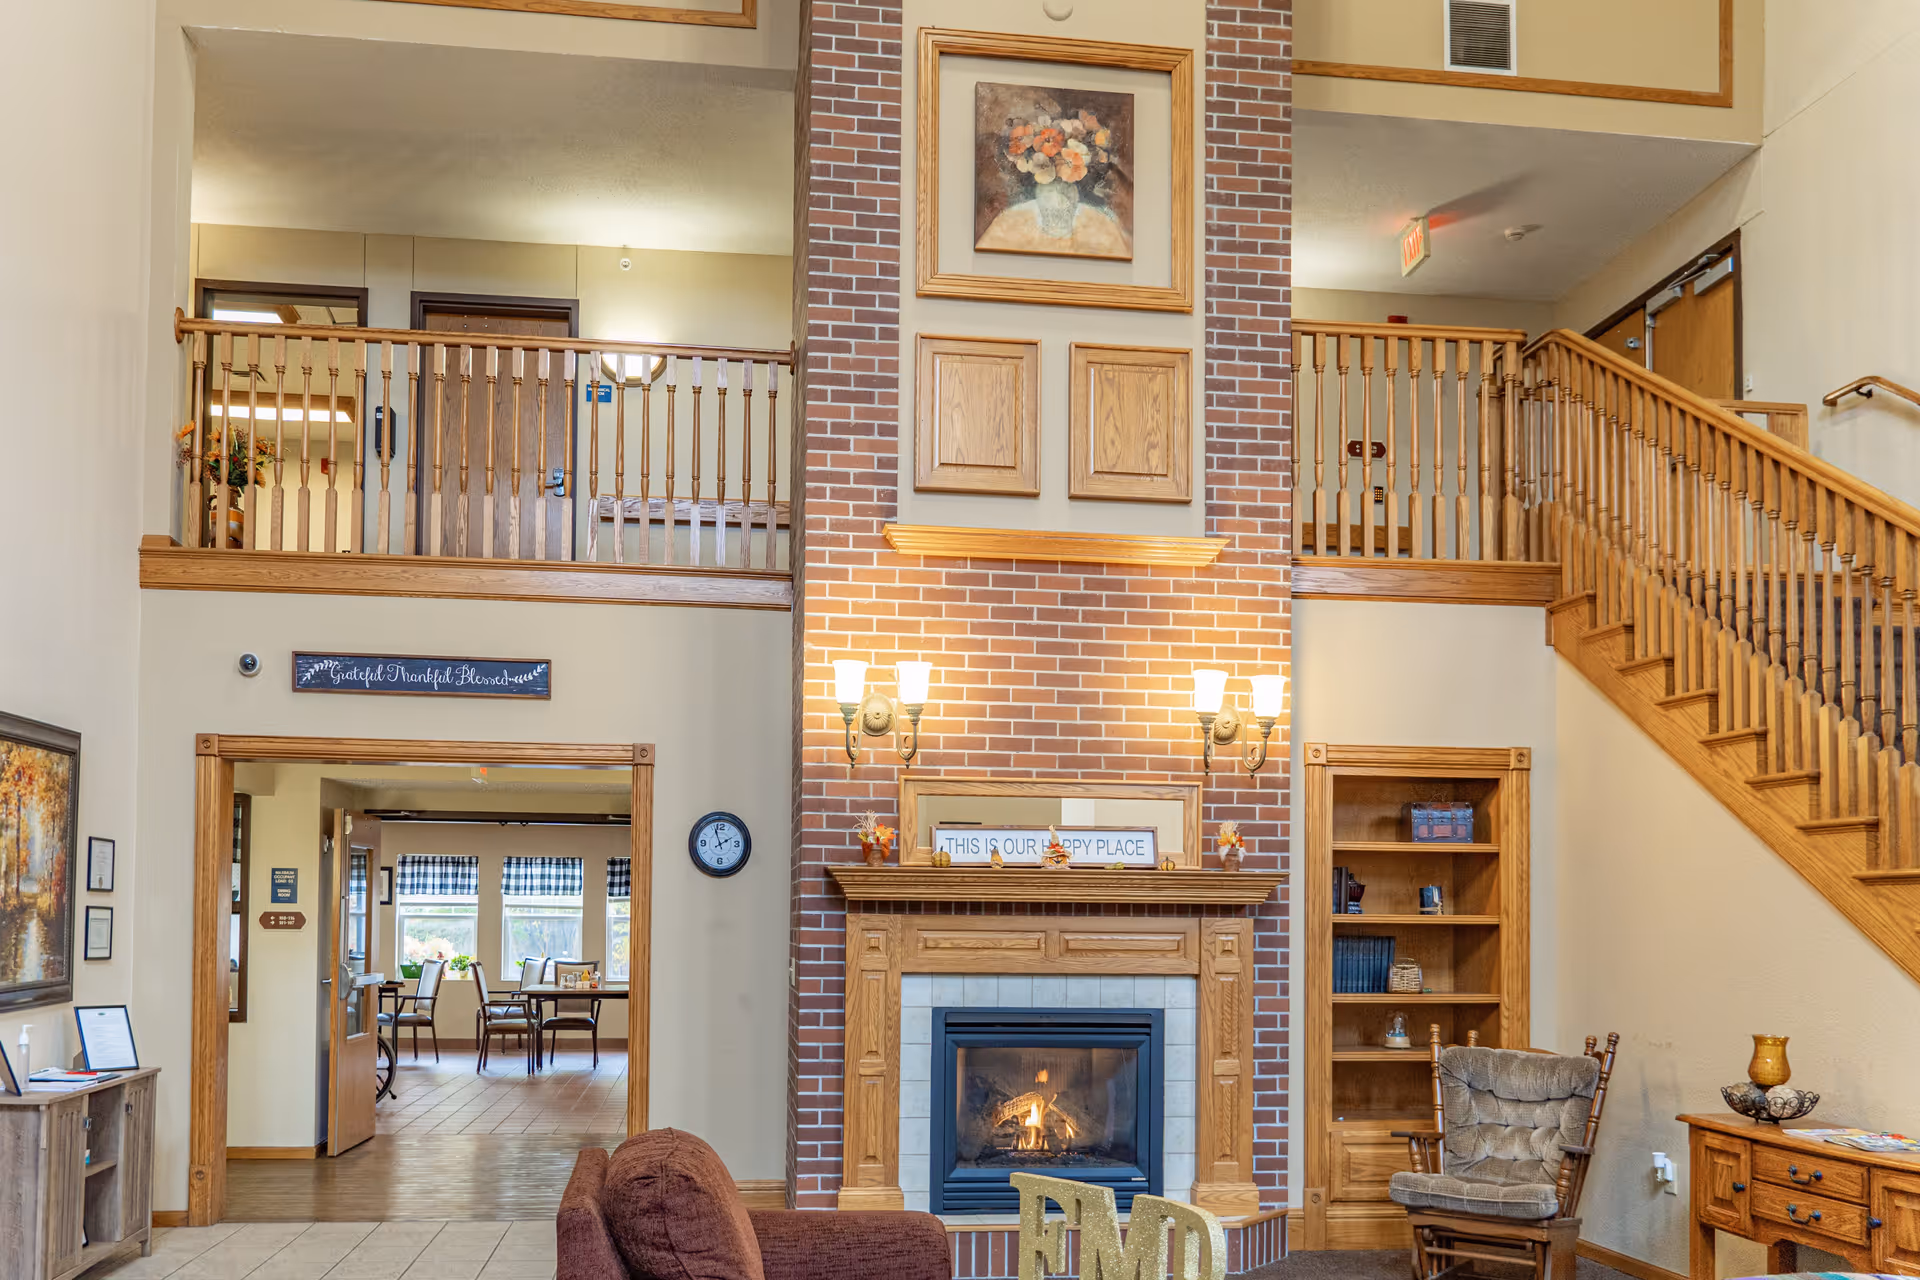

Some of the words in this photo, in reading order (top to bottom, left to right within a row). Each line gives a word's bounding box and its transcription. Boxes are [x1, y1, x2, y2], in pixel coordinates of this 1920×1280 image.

[331, 663, 386, 688] Grateful
[387, 664, 455, 690] Thankful
[455, 664, 509, 686] Blessed
[716, 823, 726, 831] 12
[700, 839, 707, 847] 9
[733, 840, 740, 848] 3
[945, 837, 980, 855] THIS
[985, 838, 999, 854] IS
[1003, 838, 1037, 855] OUR
[1041, 838, 1092, 855] HPPY
[1096, 839, 1145, 856] PLACE
[716, 857, 723, 865] 6
